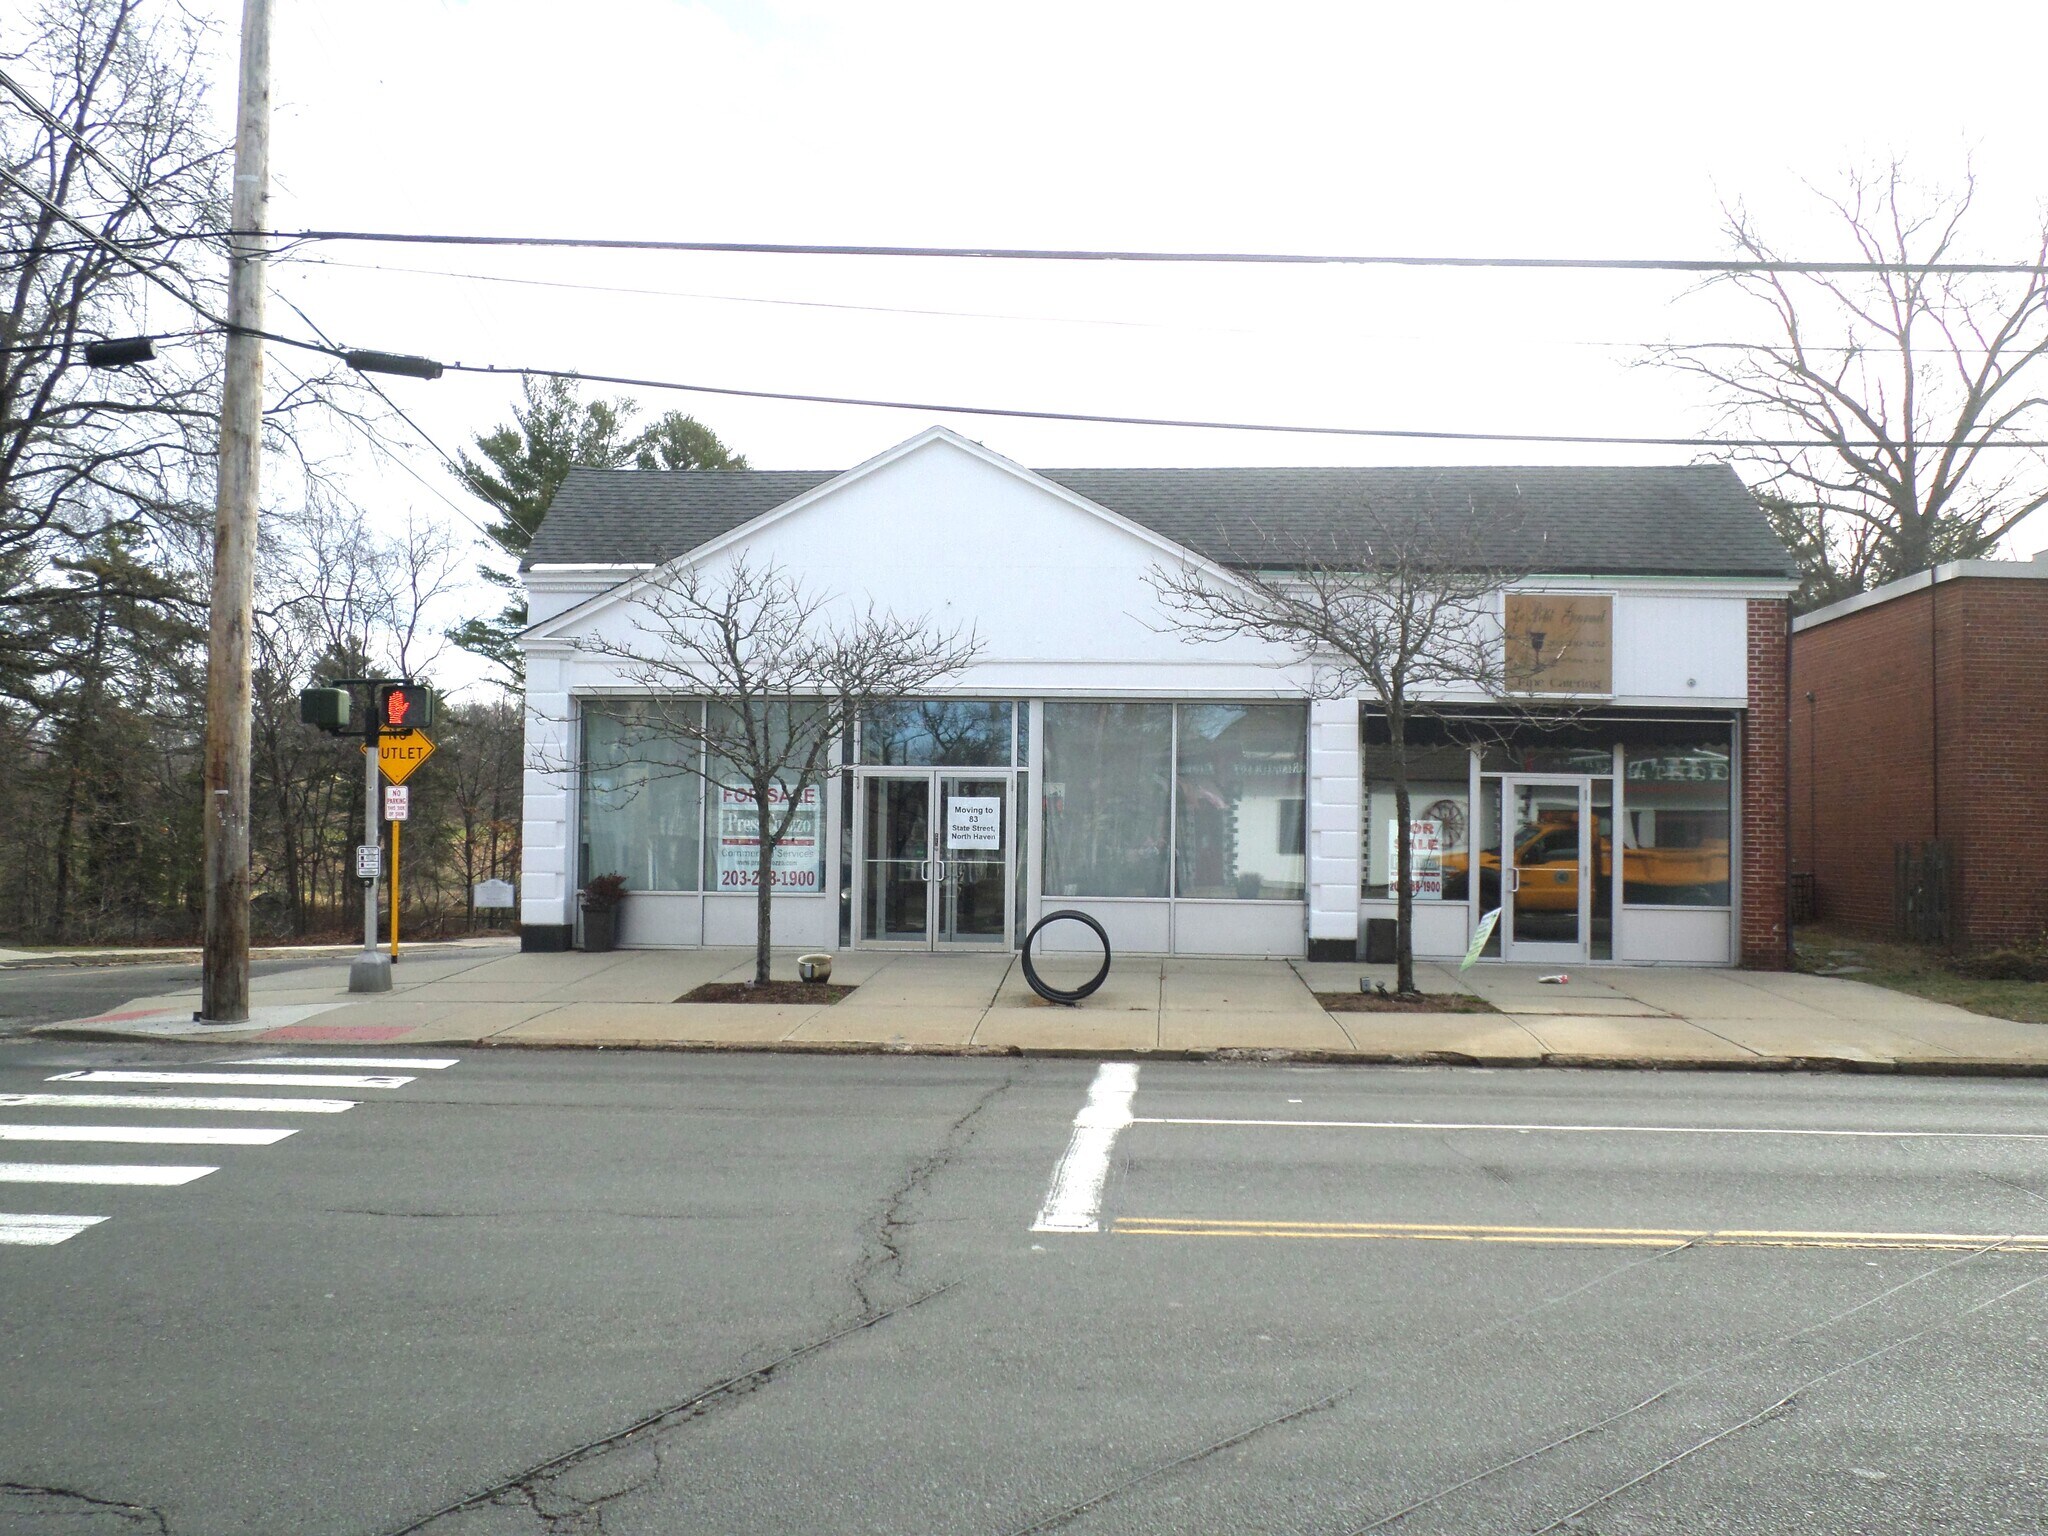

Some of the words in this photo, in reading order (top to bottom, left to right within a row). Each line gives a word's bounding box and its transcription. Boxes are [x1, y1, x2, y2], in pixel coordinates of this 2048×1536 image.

[381, 747, 423, 759] UTLET
[954, 806, 984, 815] Moving
[728, 812, 760, 833] Pres
[968, 815, 979, 823] 83
[952, 824, 970, 832] State
[971, 824, 996, 833] Street,
[1411, 823, 1434, 834] OR
[1394, 838, 1438, 850] ALE
[777, 847, 814, 858] Services
[721, 870, 815, 886] 203-28-1900
